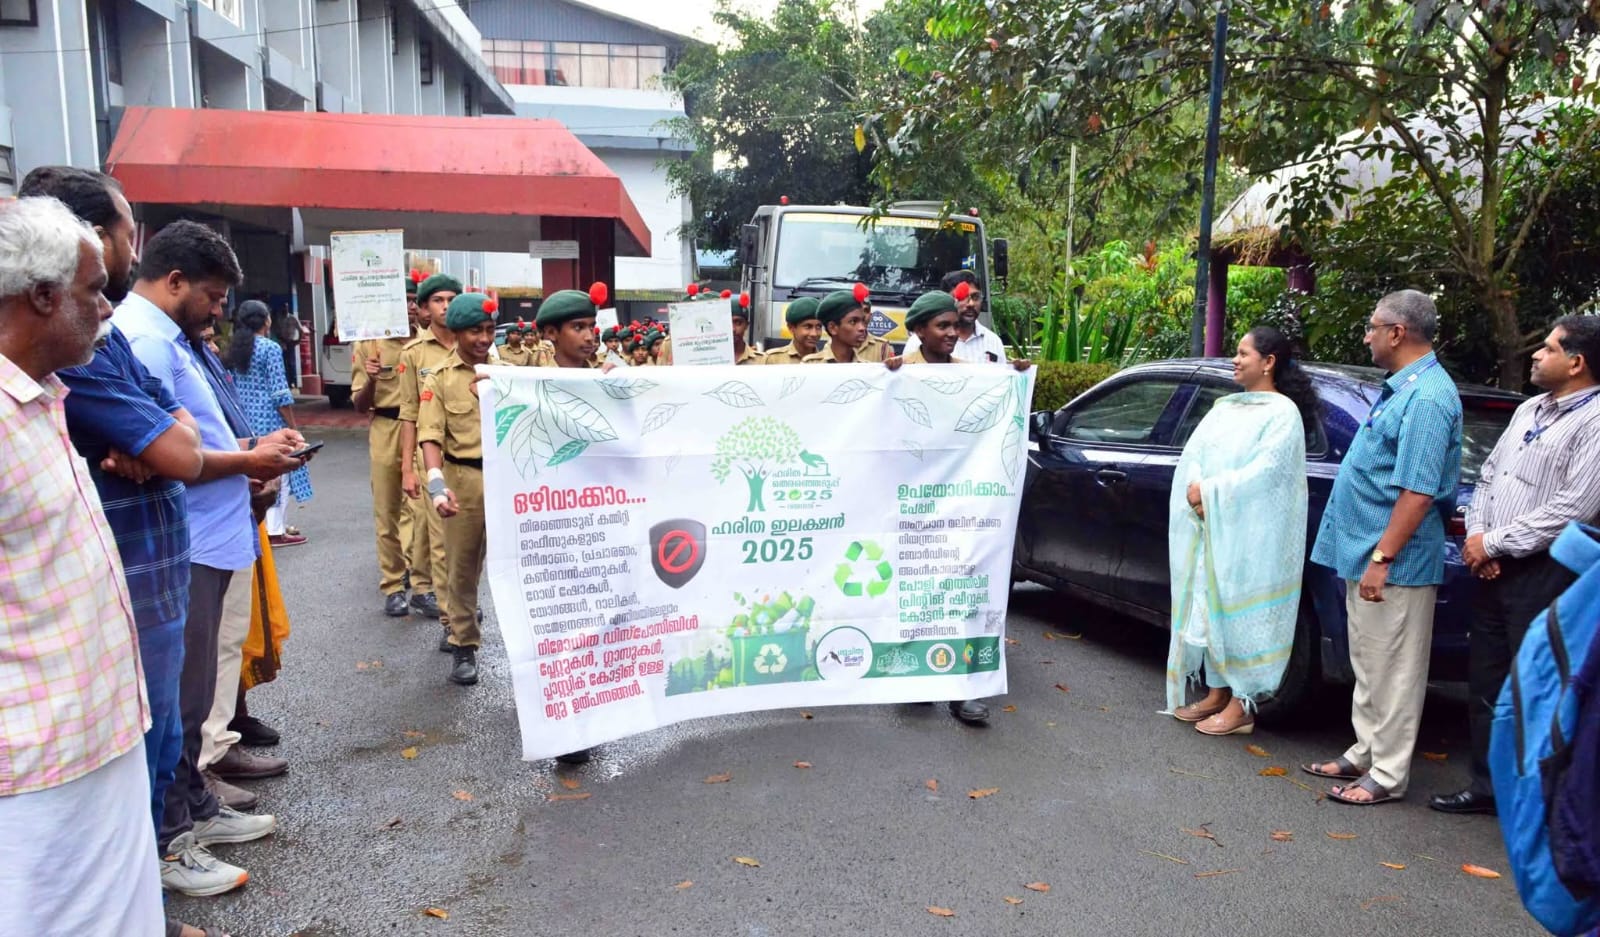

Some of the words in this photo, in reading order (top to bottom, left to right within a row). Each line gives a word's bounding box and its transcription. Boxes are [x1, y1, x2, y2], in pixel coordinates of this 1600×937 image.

[513, 485, 646, 515] ഒഴിവാക്കാം....
[772, 489, 833, 501] 2025
[519, 512, 595, 534] തിരഞ്ഞെടുപ്പ്
[711, 515, 766, 535] ഹരിത
[770, 512, 845, 537] ഇലക്ഷൻ
[520, 531, 606, 551] ഓഫീസുകളുടെ
[741, 536, 814, 564] 2025
[526, 585, 556, 602] റോഡ്
[558, 580, 613, 598] ഷോകൾ,
[603, 615, 699, 645] ഡിസ്പോസിബിൾ
[638, 659, 665, 677] ഉള്ള
[545, 701, 568, 721] മറ്റു
